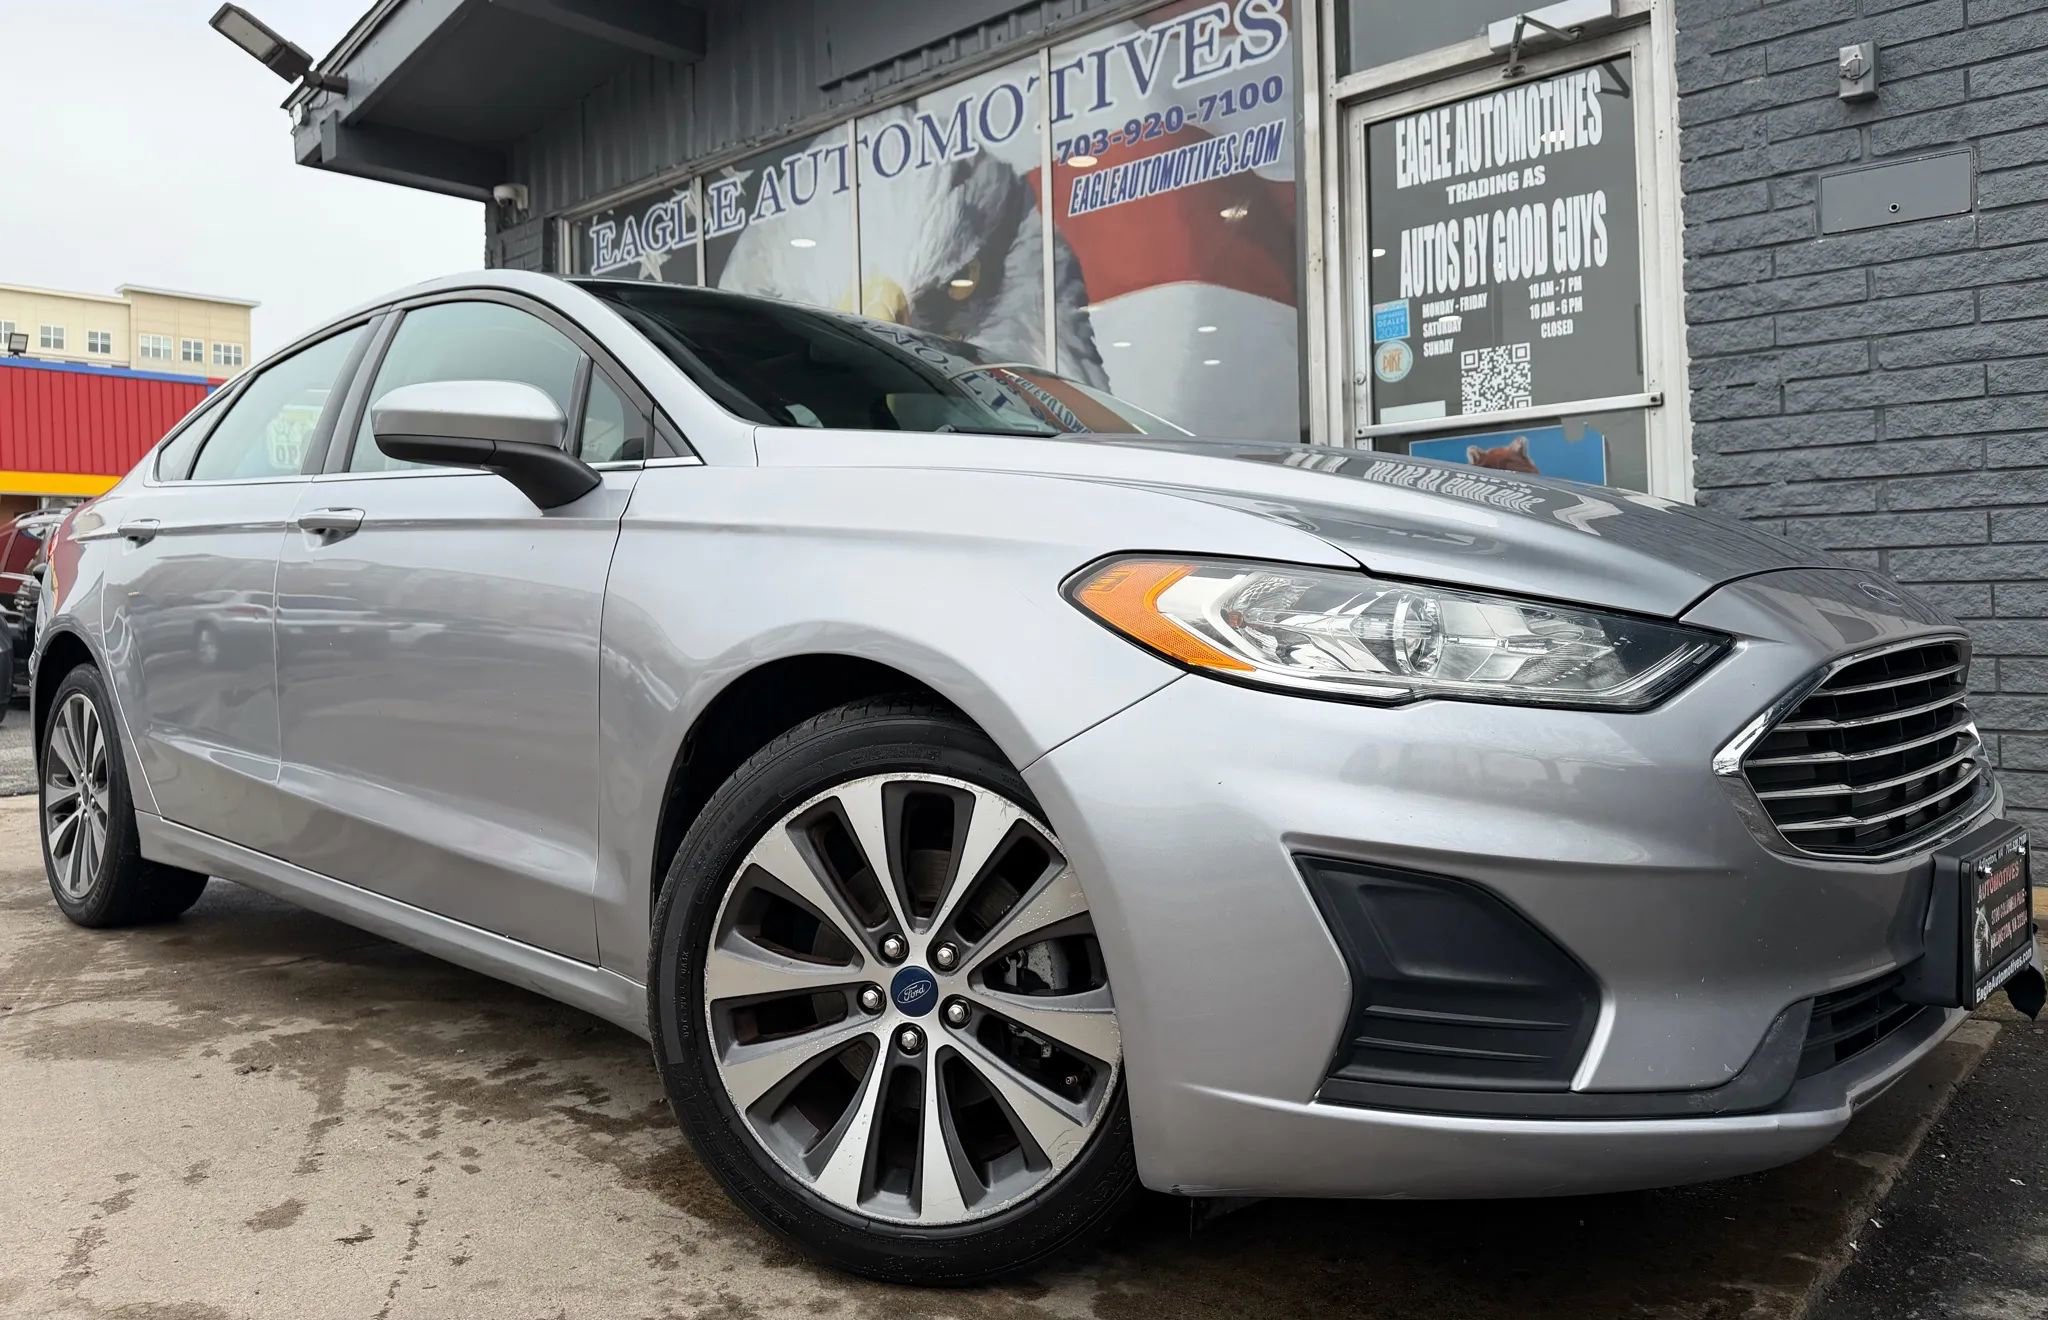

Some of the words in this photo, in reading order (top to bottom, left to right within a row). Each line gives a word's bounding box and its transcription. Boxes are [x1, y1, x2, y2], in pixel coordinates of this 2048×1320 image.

[1057, 75, 1284, 166] 703-920-7100
[1395, 108, 1452, 189] EAGLE
[1455, 69, 1603, 176] AUTOMOTIVES
[590, 177, 745, 275] EAGLE
[749, 0, 1288, 224] AUTOMOTIVES
[1068, 119, 1286, 217] EAGLEAUTOMOTIVES.COM
[1446, 171, 1519, 205] TRADING
[1522, 165, 1546, 189] AS
[1400, 219, 1460, 298] AUTOS
[1463, 213, 1489, 288] BY
[1492, 203, 1548, 283] GOOD
[1552, 190, 1608, 273] GUYS
[1528, 283, 1540, 299] 10
[1540, 280, 1554, 297] AM
[1559, 279, 1565, 294] 7
[1567, 275, 1582, 293] PM
[1422, 298, 1455, 318] MONDAY
[1460, 292, 1488, 312] FRIDAY
[1529, 303, 1540, 320] 10
[1541, 301, 1555, 318] AM
[1561, 299, 1567, 315] 6
[1568, 296, 1583, 313] PM
[1423, 317, 1462, 338] SATURDAY
[1541, 319, 1573, 338] CLOSED
[1423, 338, 1454, 357] SUNDAY
[1976, 947, 2032, 1003] EagleAutomotives.com
[903, 984, 926, 1001] Ford
